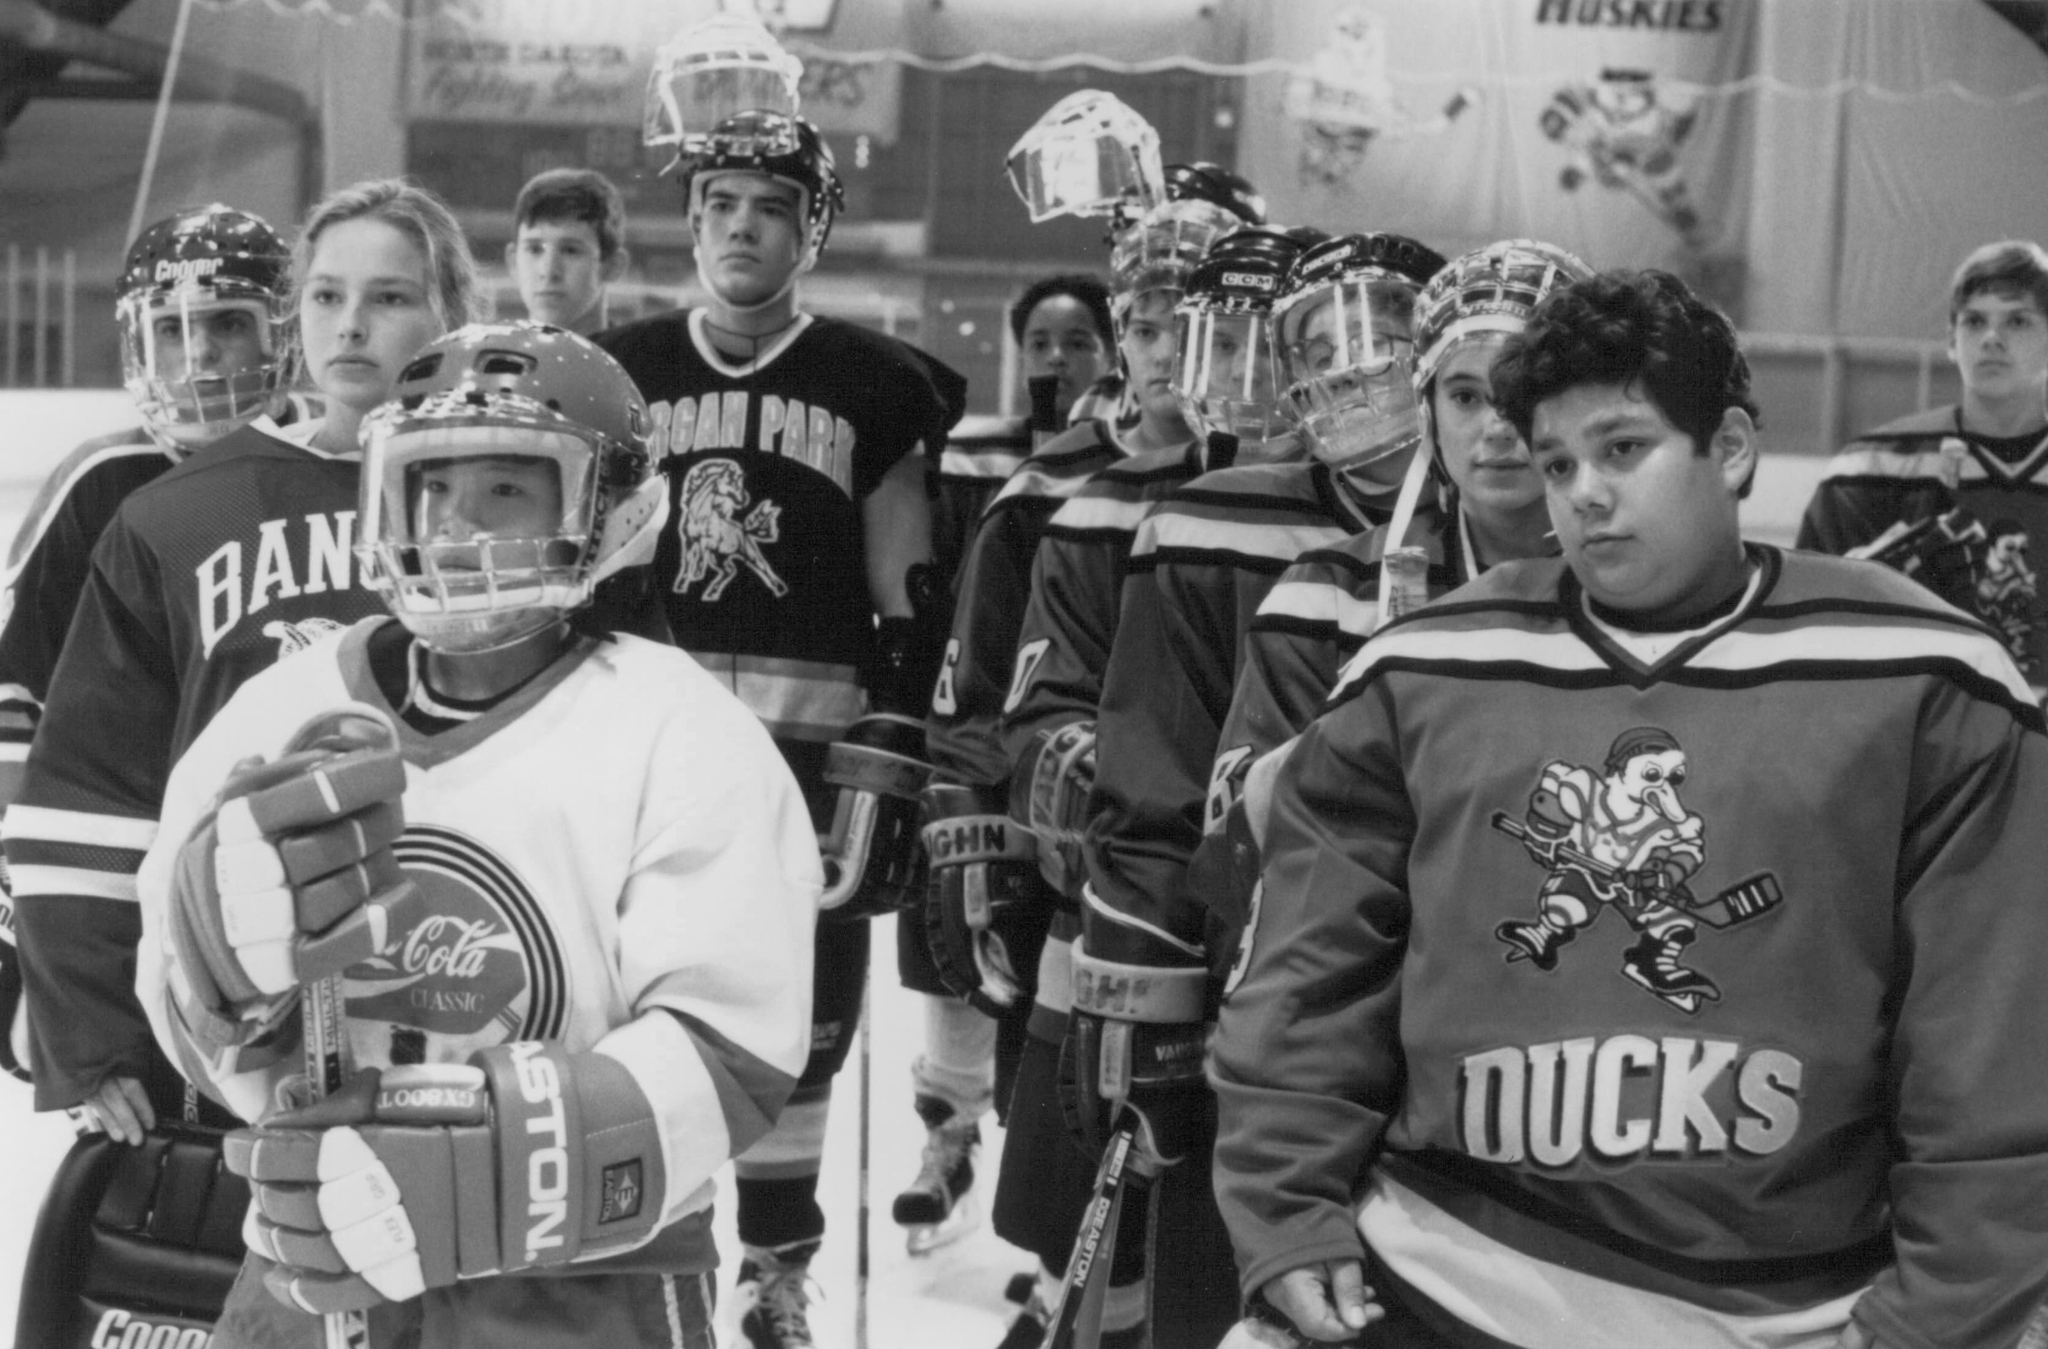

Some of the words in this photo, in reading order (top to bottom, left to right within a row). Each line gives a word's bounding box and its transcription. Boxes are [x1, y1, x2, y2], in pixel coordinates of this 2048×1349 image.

[155, 258, 224, 282] Cooper
[1222, 272, 1274, 289] CCM
[410, 988, 486, 1014] CLASSIC
[1457, 1034, 1803, 1167] DUCKS
